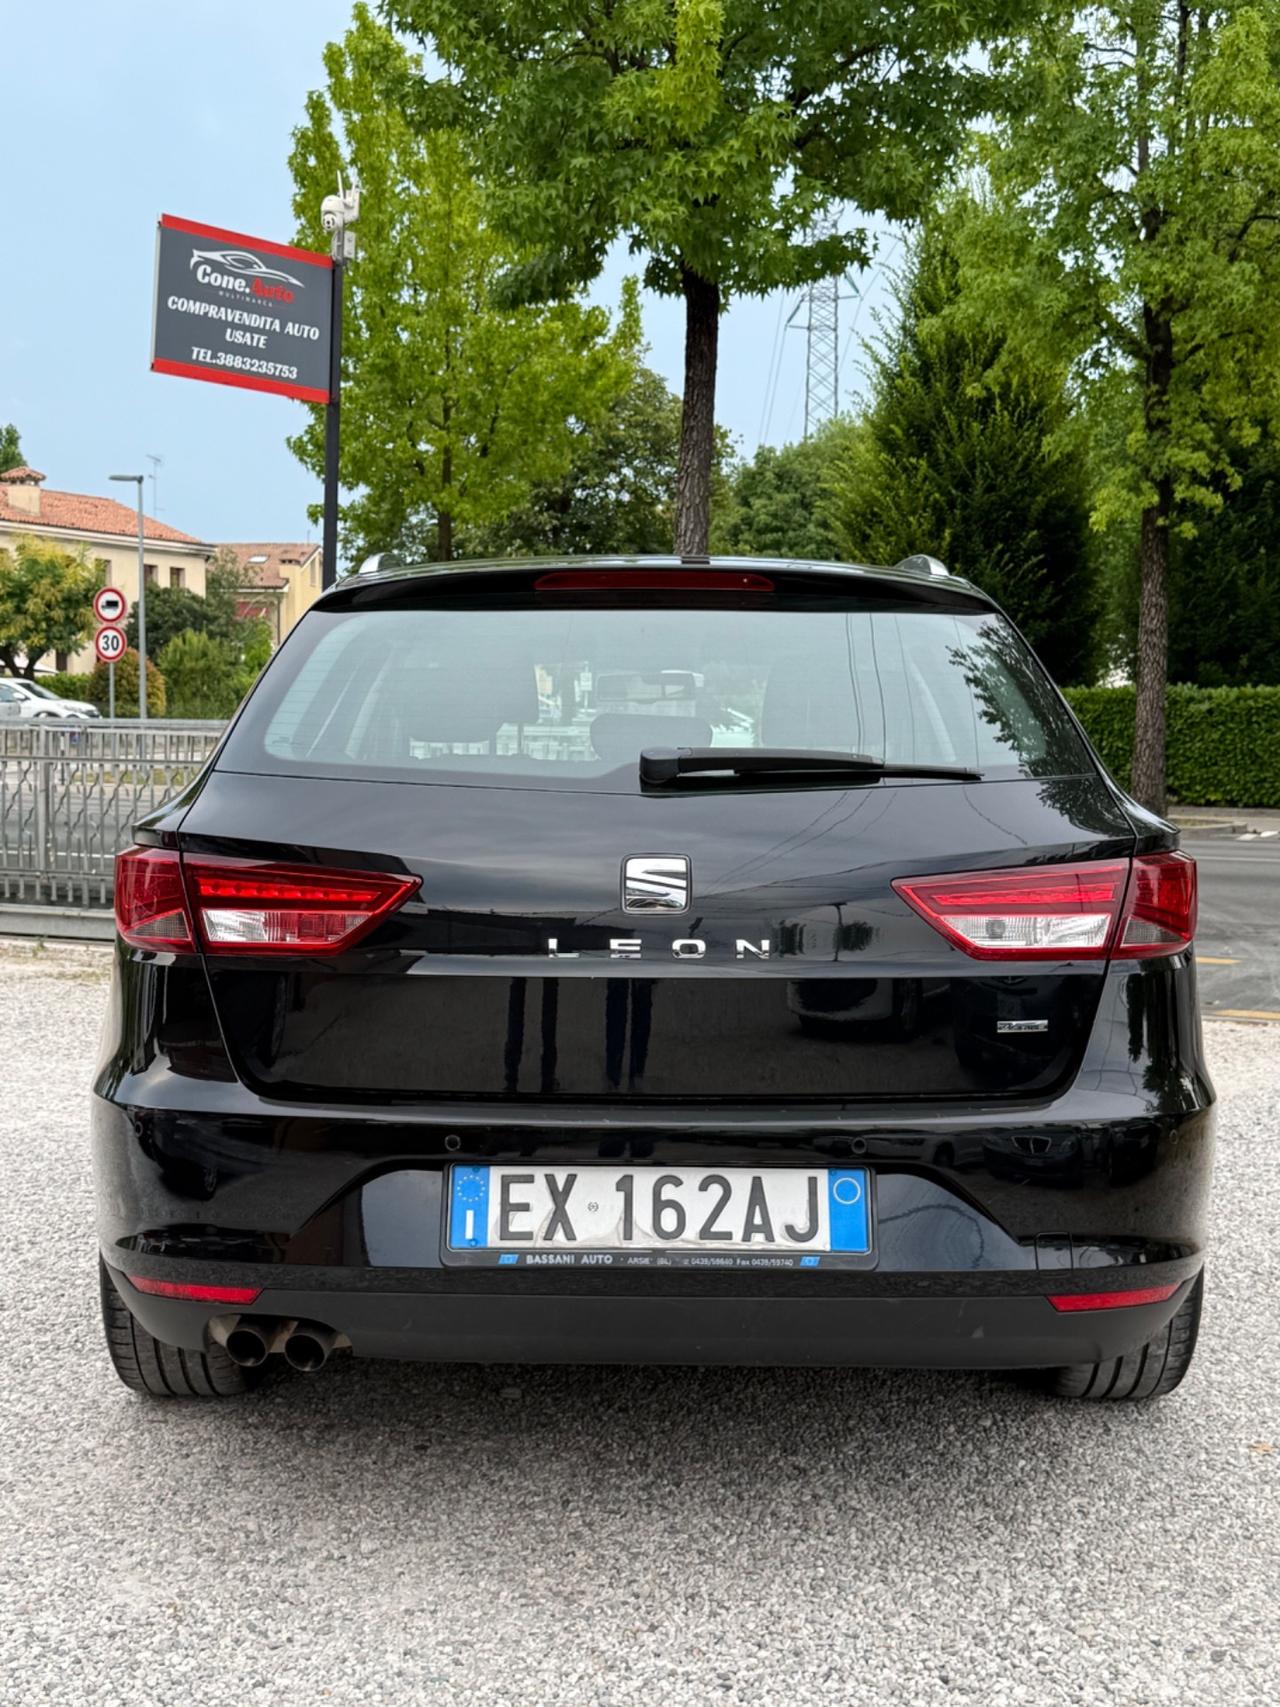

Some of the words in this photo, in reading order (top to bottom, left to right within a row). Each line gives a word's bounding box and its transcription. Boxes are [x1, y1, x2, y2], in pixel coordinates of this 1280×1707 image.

[167, 295, 281, 333] COMPRAVENDITA
[284, 321, 320, 341] AUTO
[225, 328, 268, 349] USATE
[191, 346, 298, 379] TEL.3883235753
[101, 634, 120, 651] 30
[548, 938, 770, 959] LEON
[499, 1173, 578, 1241] EX
[615, 1174, 819, 1243] 162AJ
[526, 1254, 575, 1265] BASSANI
[581, 1254, 613, 1265] AUTO
